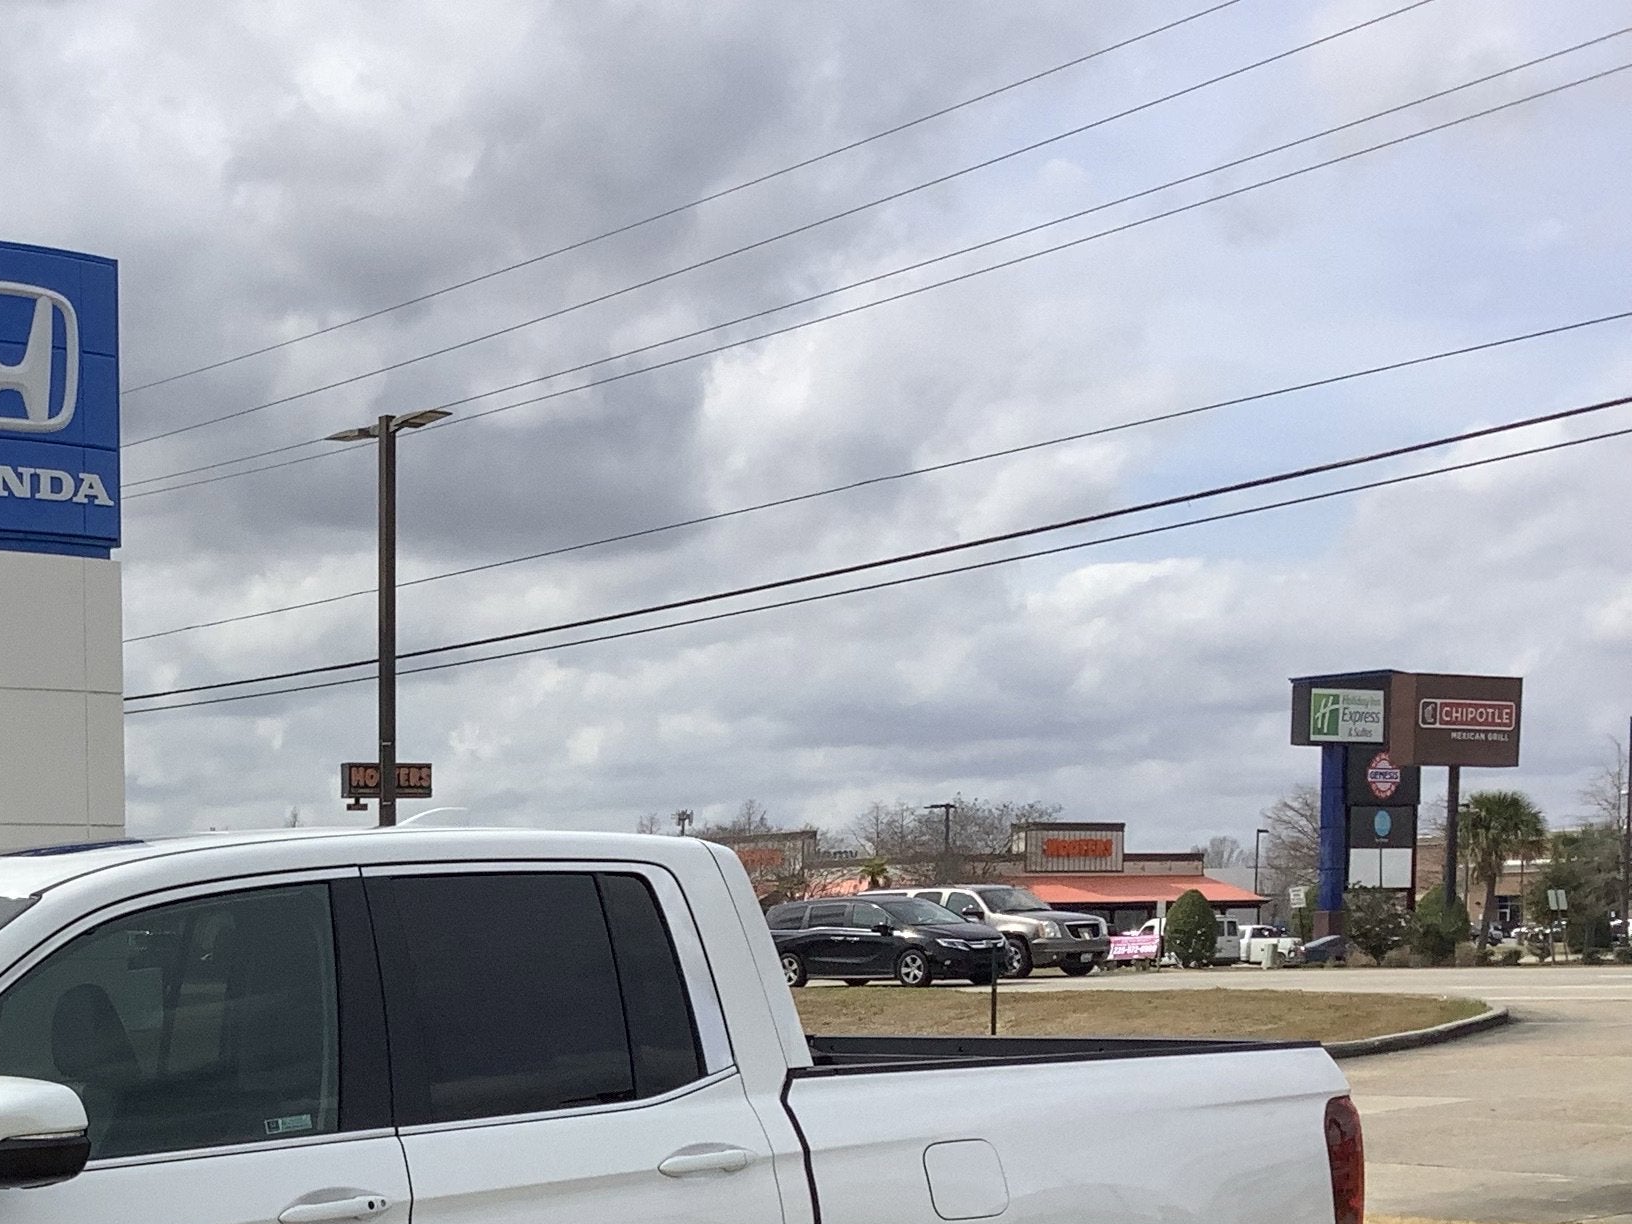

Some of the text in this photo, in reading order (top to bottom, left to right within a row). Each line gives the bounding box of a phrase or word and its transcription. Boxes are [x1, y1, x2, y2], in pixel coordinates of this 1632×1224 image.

[1342, 706, 1381, 725] Express
[1441, 706, 1511, 723] CHIPOTLE
[1450, 731, 1510, 742] MEXICAN GRILL
[1370, 771, 1399, 780] GENESIS
